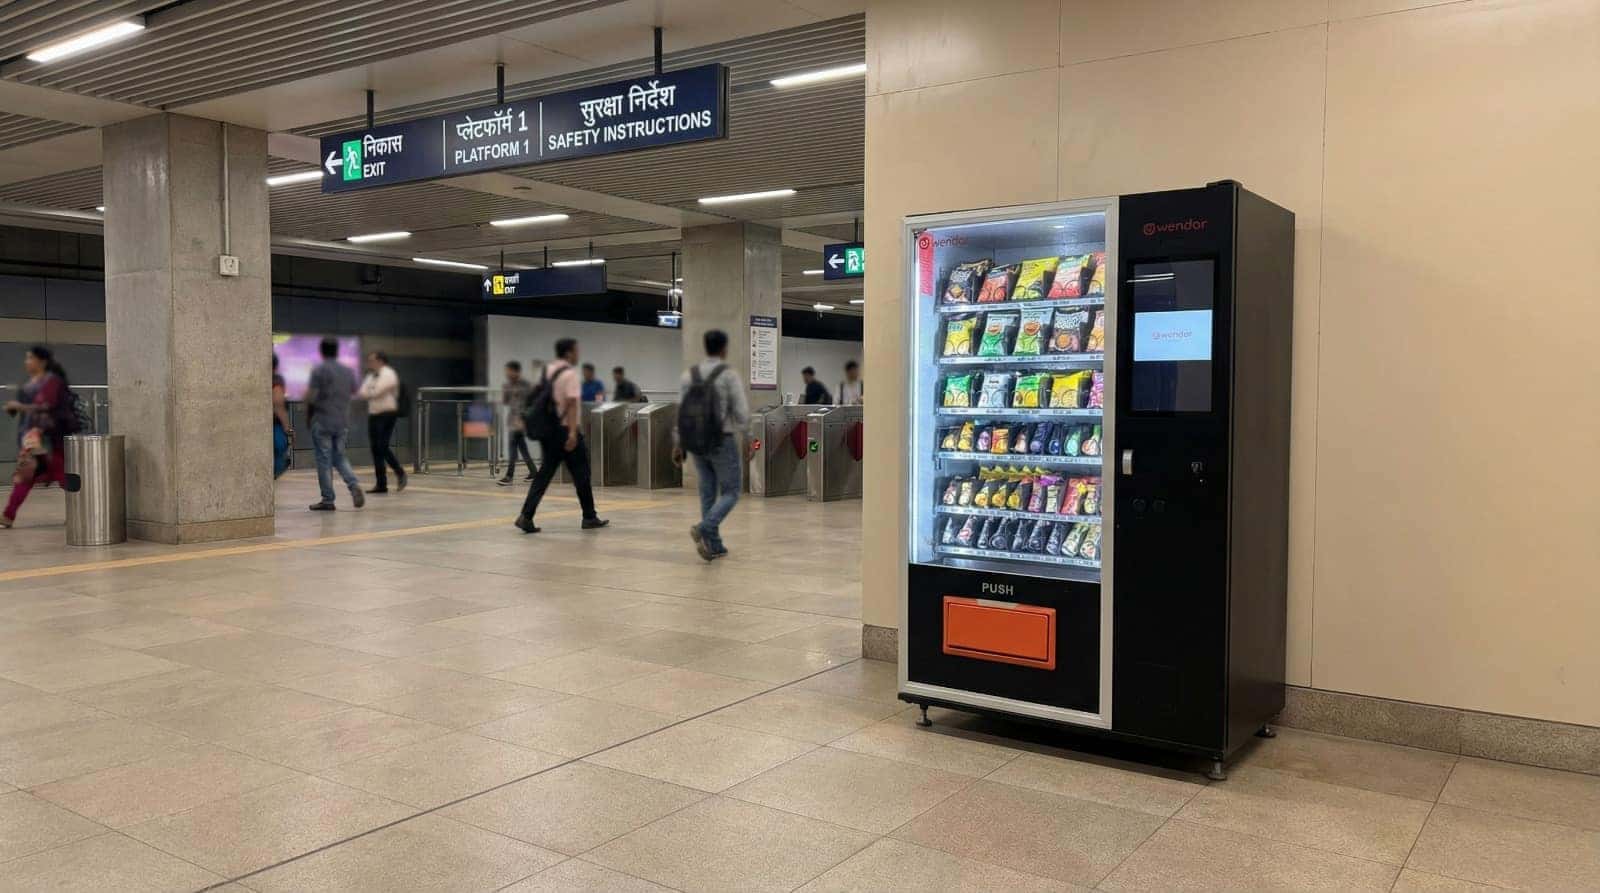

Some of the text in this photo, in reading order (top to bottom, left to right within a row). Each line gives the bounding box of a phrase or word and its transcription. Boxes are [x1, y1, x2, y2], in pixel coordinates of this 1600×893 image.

[579, 80, 676, 126] सुरक्षा निर्देश
[456, 107, 528, 140] प्लेटफॉर्म 1
[548, 110, 712, 150] SAFETY INSTRUCTIONS
[363, 134, 403, 158] निकास
[455, 139, 529, 165] PLATFORM 1
[363, 161, 386, 178] EXIT
[1156, 218, 1208, 232] wendor
[982, 582, 1014, 596] PUSH
